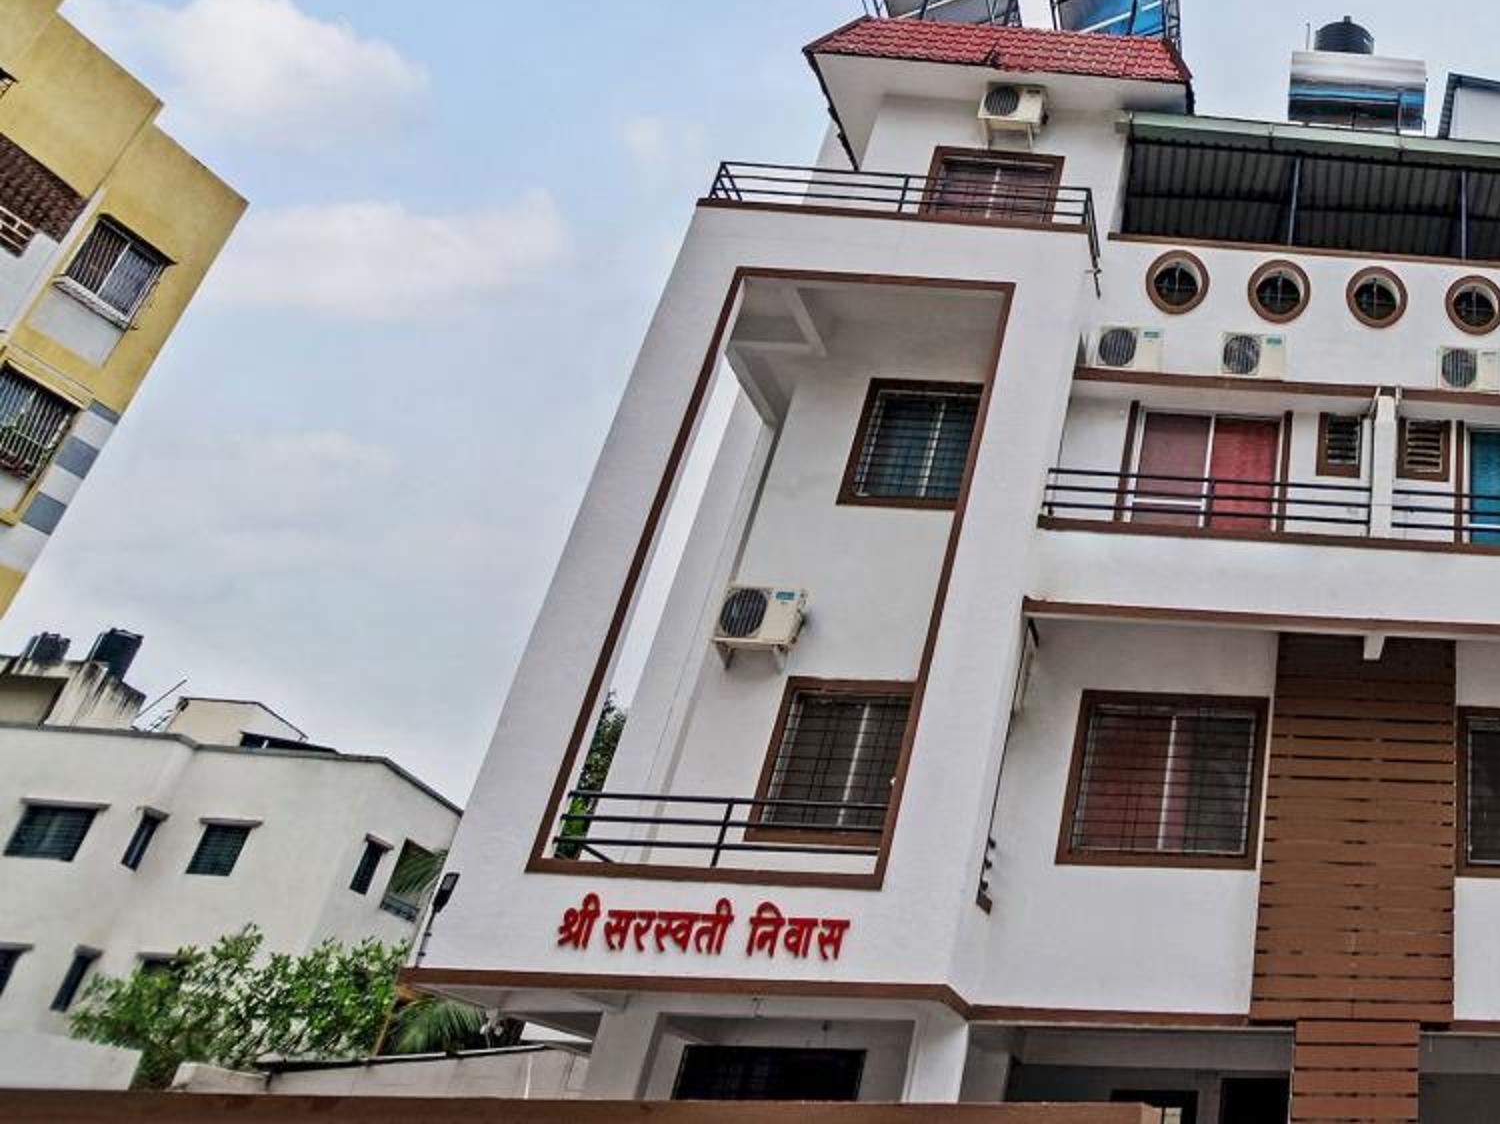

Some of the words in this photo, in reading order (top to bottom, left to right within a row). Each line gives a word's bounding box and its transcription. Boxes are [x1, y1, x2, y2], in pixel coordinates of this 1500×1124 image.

[557, 892, 601, 951] श्री
[603, 897, 735, 957] सरस्वती
[745, 901, 851, 961] निवास
